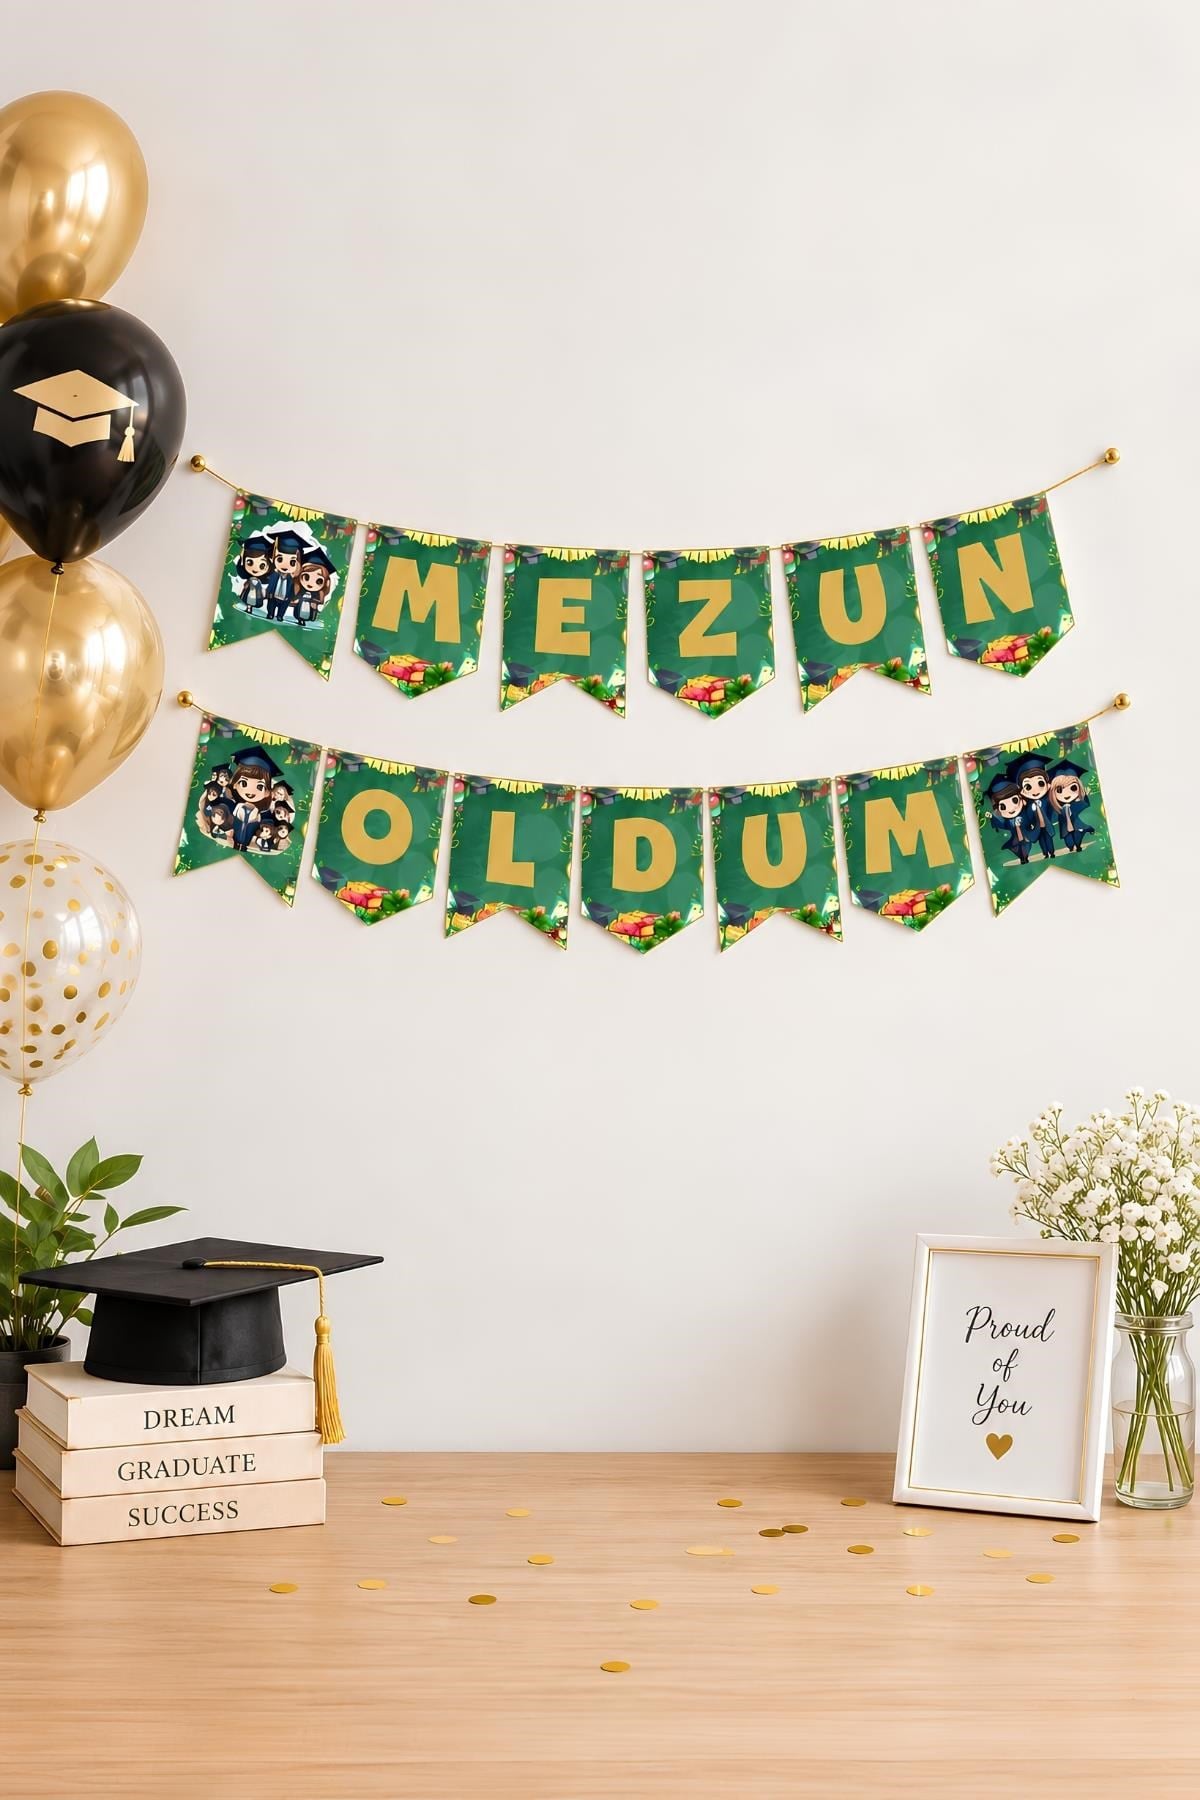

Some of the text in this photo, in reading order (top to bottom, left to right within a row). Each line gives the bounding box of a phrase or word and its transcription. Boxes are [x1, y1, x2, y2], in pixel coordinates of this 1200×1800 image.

[371, 533, 1034, 658] MEZUN
[341, 788, 955, 893] OLDUM
[965, 1305, 1056, 1343] Proud
[992, 1348, 1018, 1382] of
[143, 1404, 235, 1430] DREAM
[971, 1383, 1032, 1425] You
[117, 1453, 257, 1482] GRADUATE
[128, 1500, 239, 1527] SUCCESS
